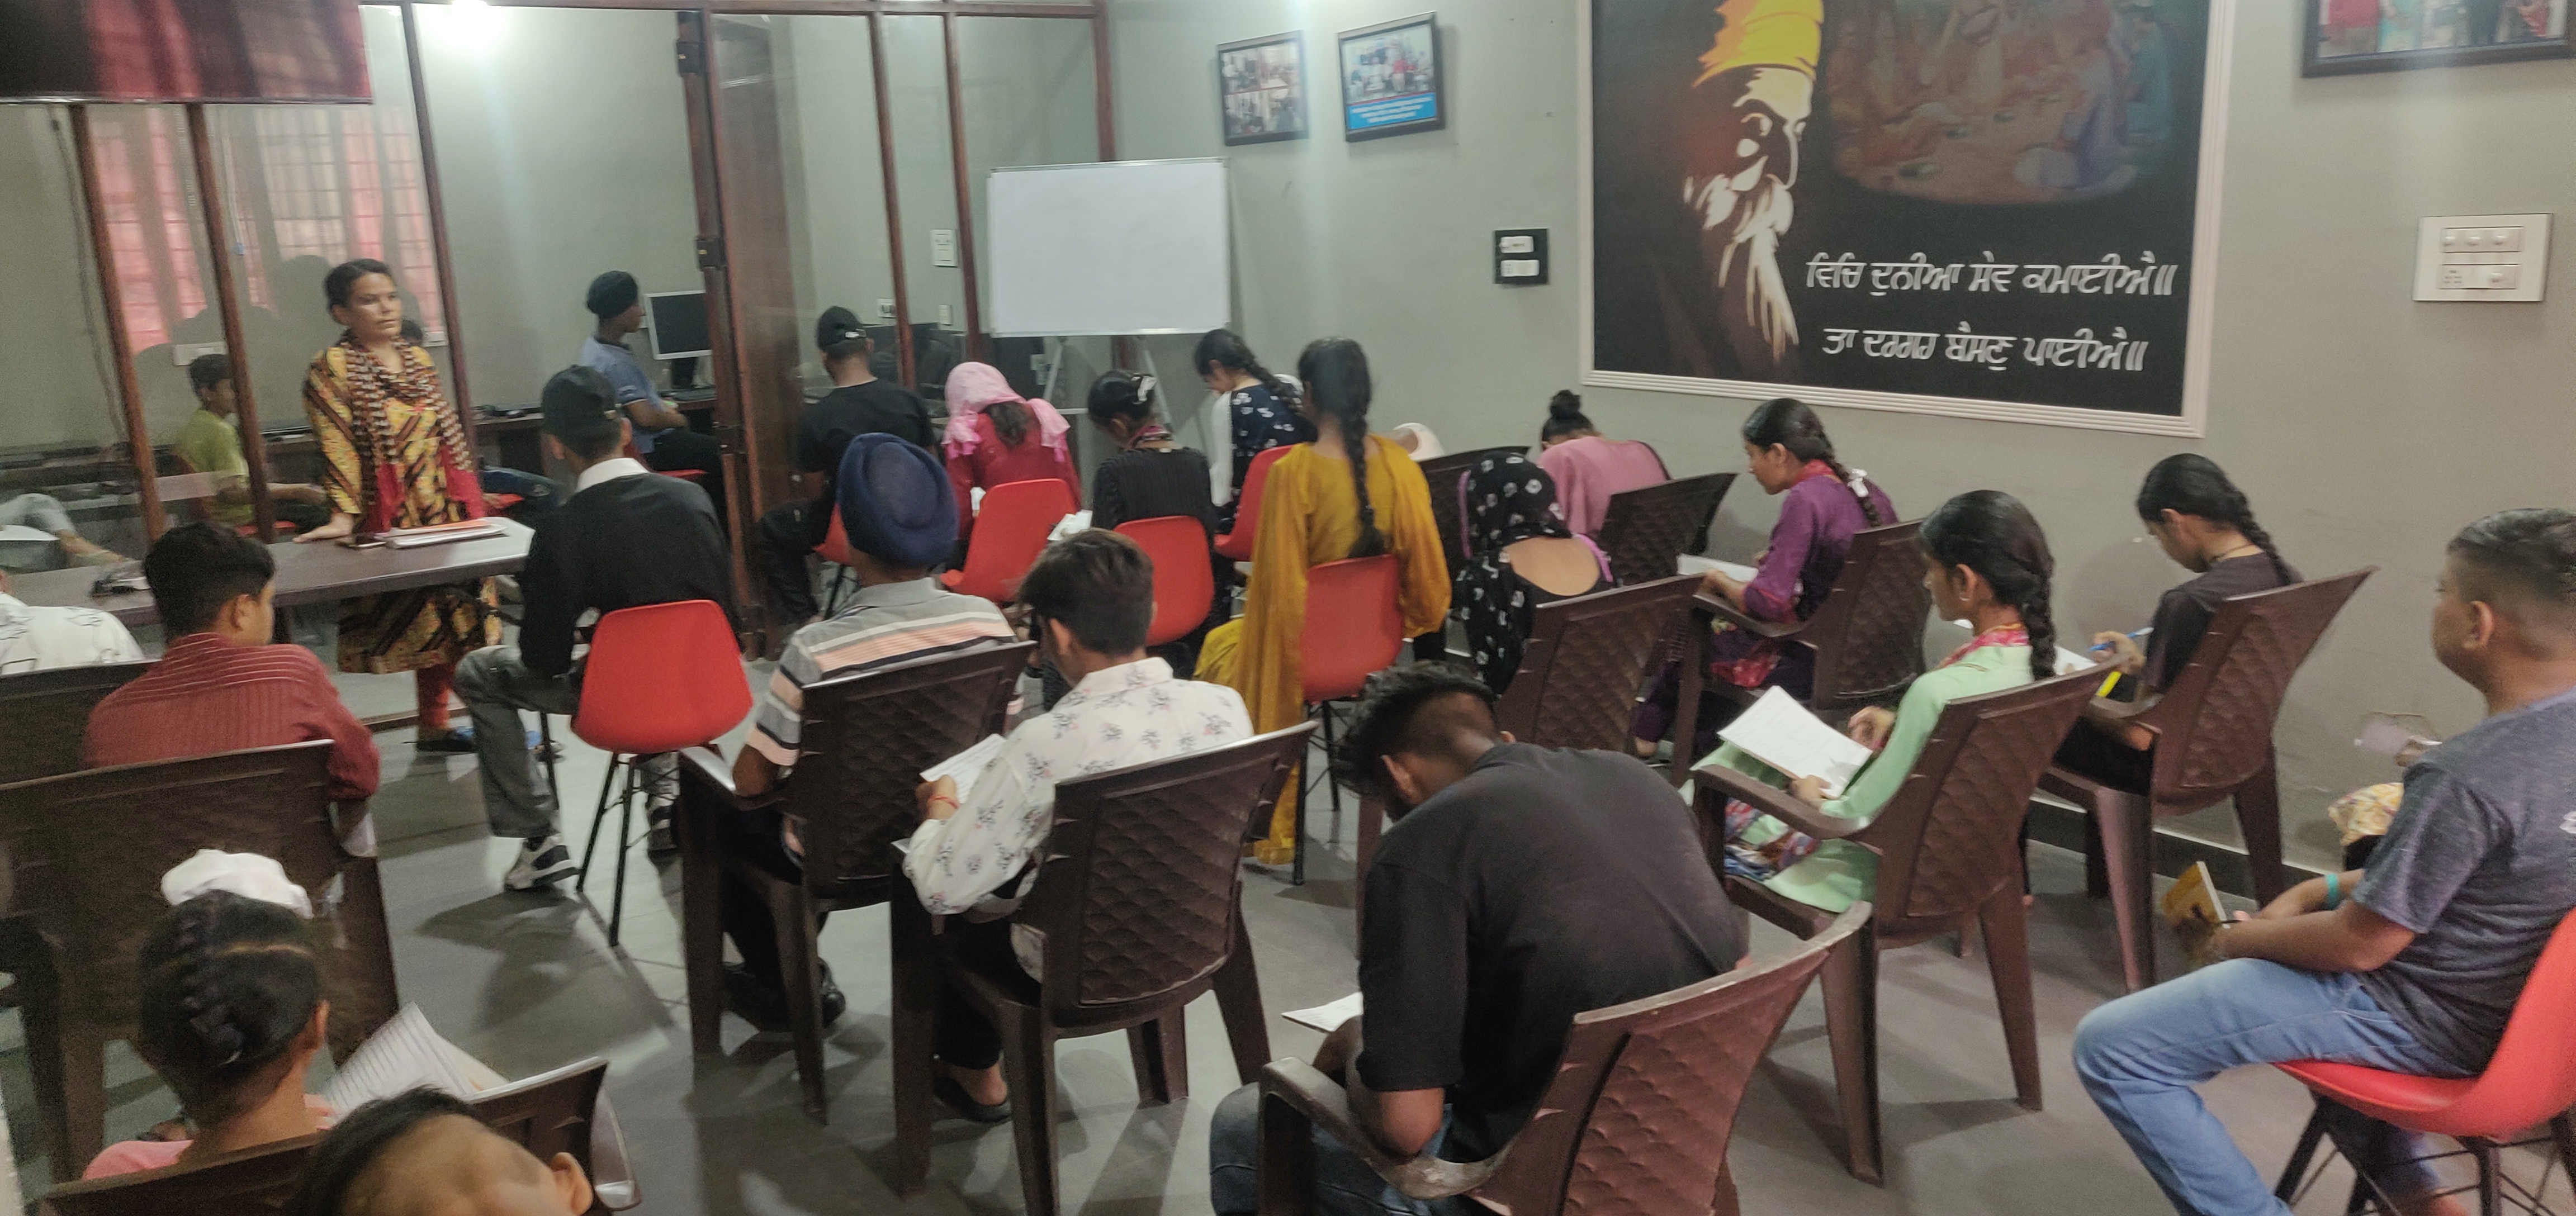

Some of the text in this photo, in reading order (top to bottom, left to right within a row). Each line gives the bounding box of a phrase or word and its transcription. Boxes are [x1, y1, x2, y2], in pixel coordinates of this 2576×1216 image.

[1806, 251, 1867, 288] ਵਿਚਿ
[1869, 251, 1966, 296] ਦੁਨੀਆ
[1968, 250, 2019, 292] ਸੇਵ
[1822, 328, 1860, 354] ਤਾ
[1944, 321, 2018, 371] ਬੈਸਣੁ
